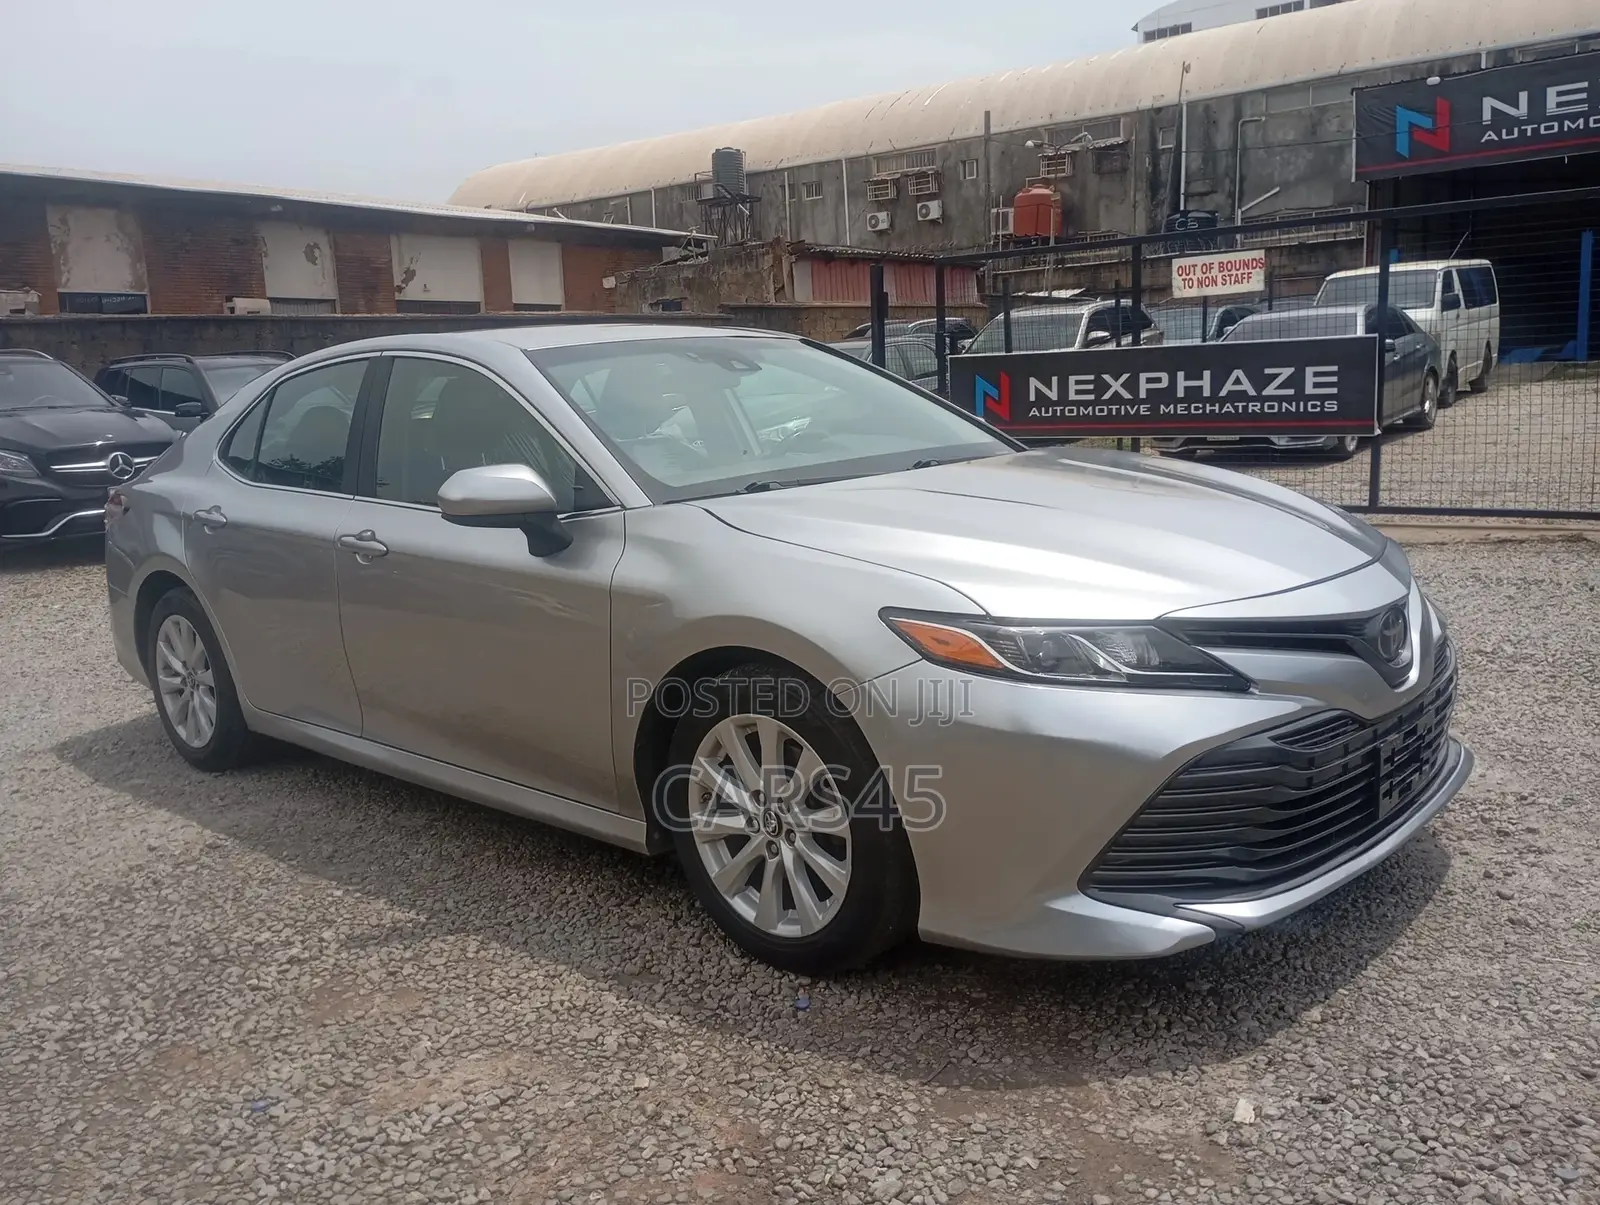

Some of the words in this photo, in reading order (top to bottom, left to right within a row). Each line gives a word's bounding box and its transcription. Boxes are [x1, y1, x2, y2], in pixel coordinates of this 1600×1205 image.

[1482, 81, 1600, 125] NE
[1177, 264, 1198, 277] OUT
[1201, 262, 1215, 275] OF
[1218, 257, 1265, 273] BOUNDS
[1182, 278, 1194, 289] TO
[1197, 275, 1218, 289] NON
[1221, 272, 1253, 286] STAFF
[1029, 365, 1339, 401] NEXPHAZE
[1028, 404, 1151, 417] AUTOMOTIVE
[1160, 400, 1338, 414] MECHATRONICS
